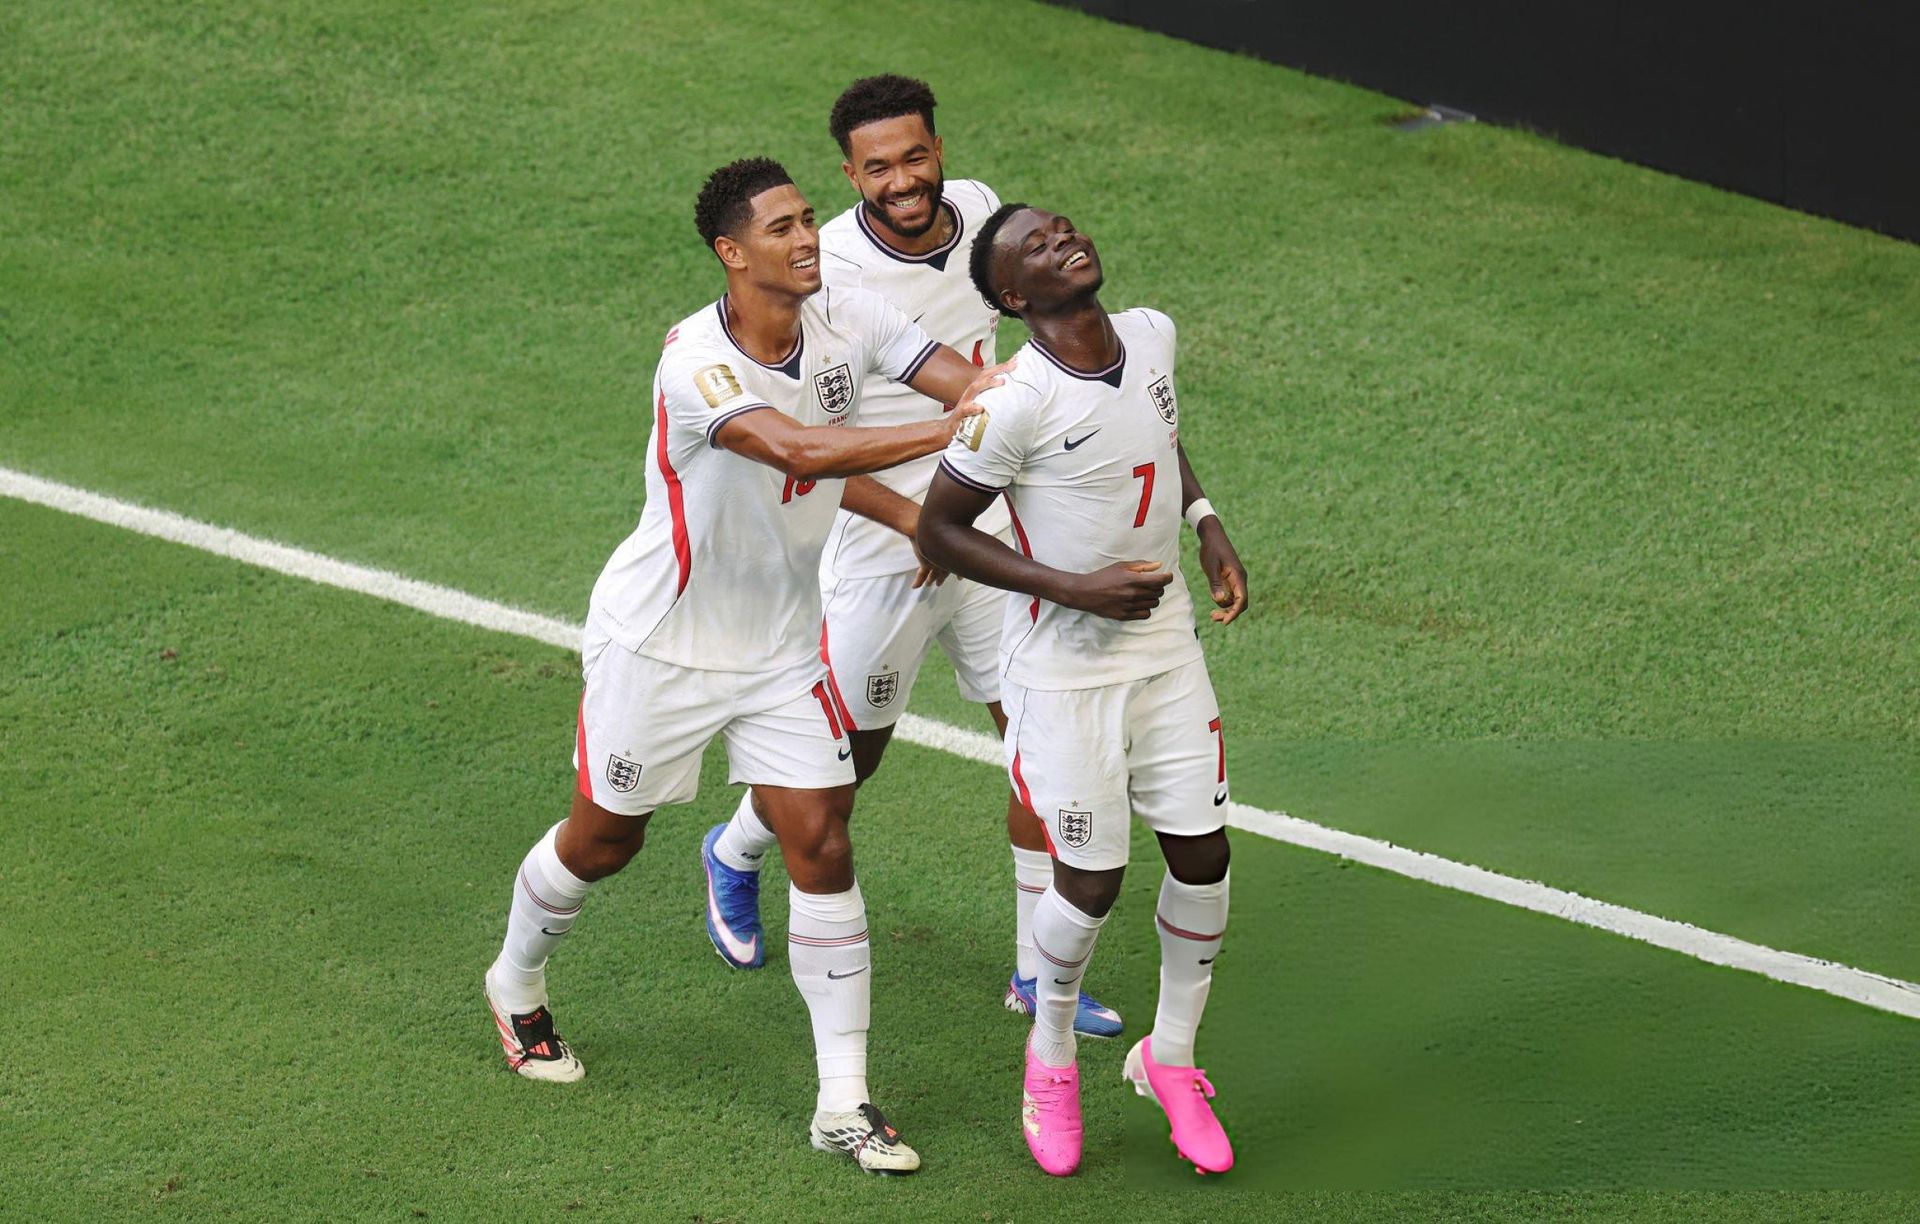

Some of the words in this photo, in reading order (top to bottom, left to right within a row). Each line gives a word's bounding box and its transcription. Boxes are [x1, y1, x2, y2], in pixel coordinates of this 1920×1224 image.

[828, 411, 850, 426] FRANC
[1133, 462, 1156, 528] 7
[1208, 716, 1225, 784] 7
